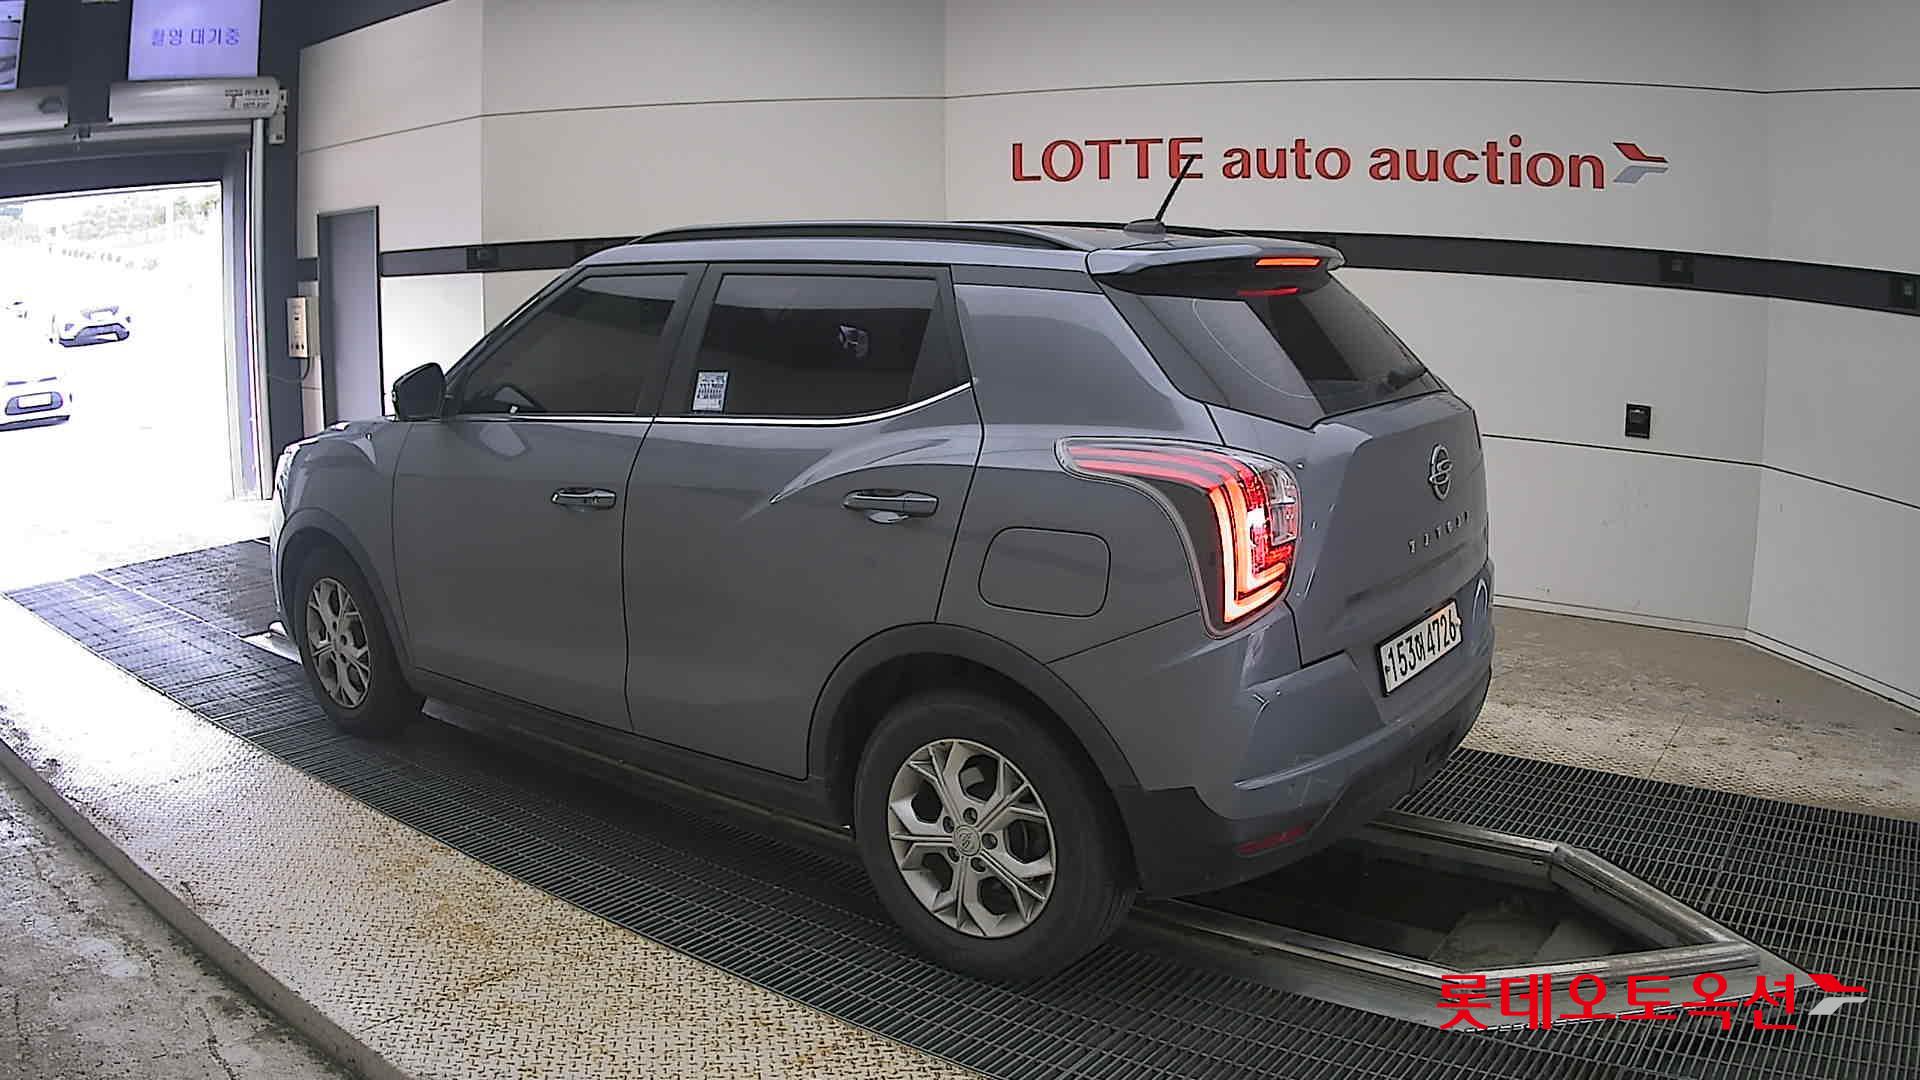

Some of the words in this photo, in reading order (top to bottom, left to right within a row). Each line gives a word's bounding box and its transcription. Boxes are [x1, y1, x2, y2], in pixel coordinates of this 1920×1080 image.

[1011, 136, 1204, 182] LOTTE
[1221, 137, 1351, 180] auto
[1368, 133, 1606, 190] auction
